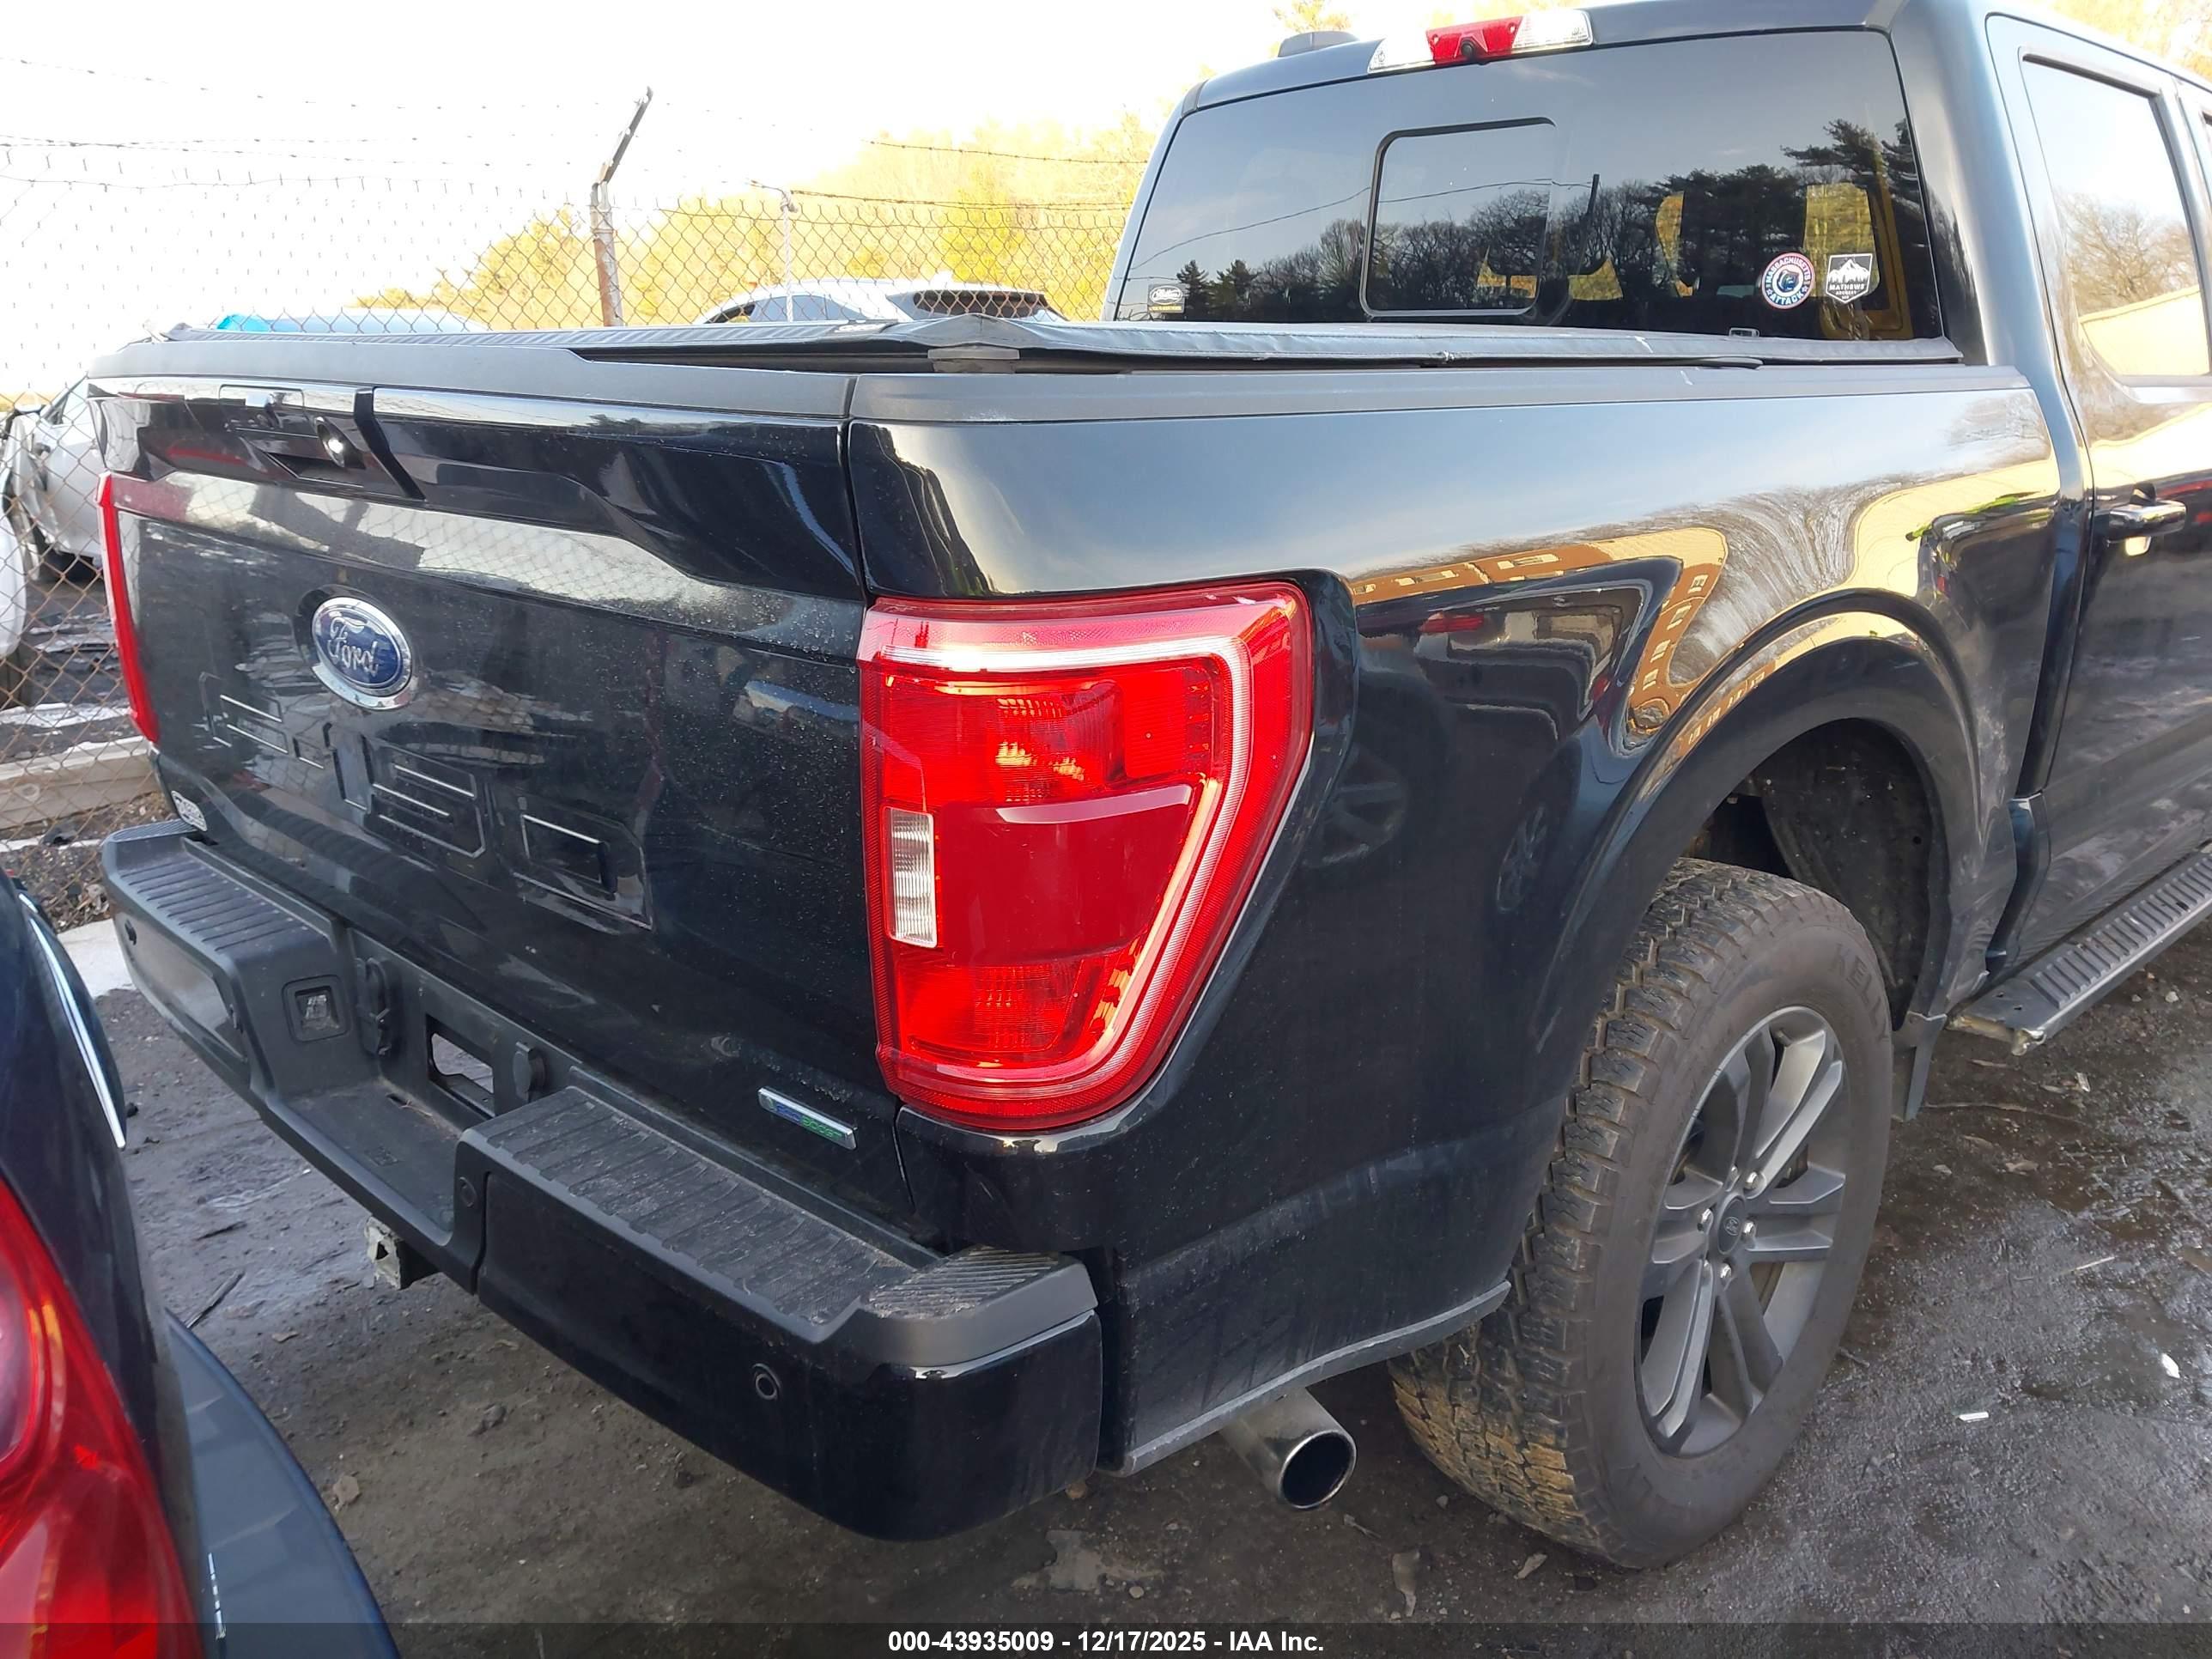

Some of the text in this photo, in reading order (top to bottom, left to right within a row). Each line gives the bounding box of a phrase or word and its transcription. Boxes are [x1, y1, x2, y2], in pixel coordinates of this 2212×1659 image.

[1765, 256, 1811, 282] MASSACHUSETTS
[1769, 290, 1804, 305] ATTACK
[327, 617, 379, 677] Ford
